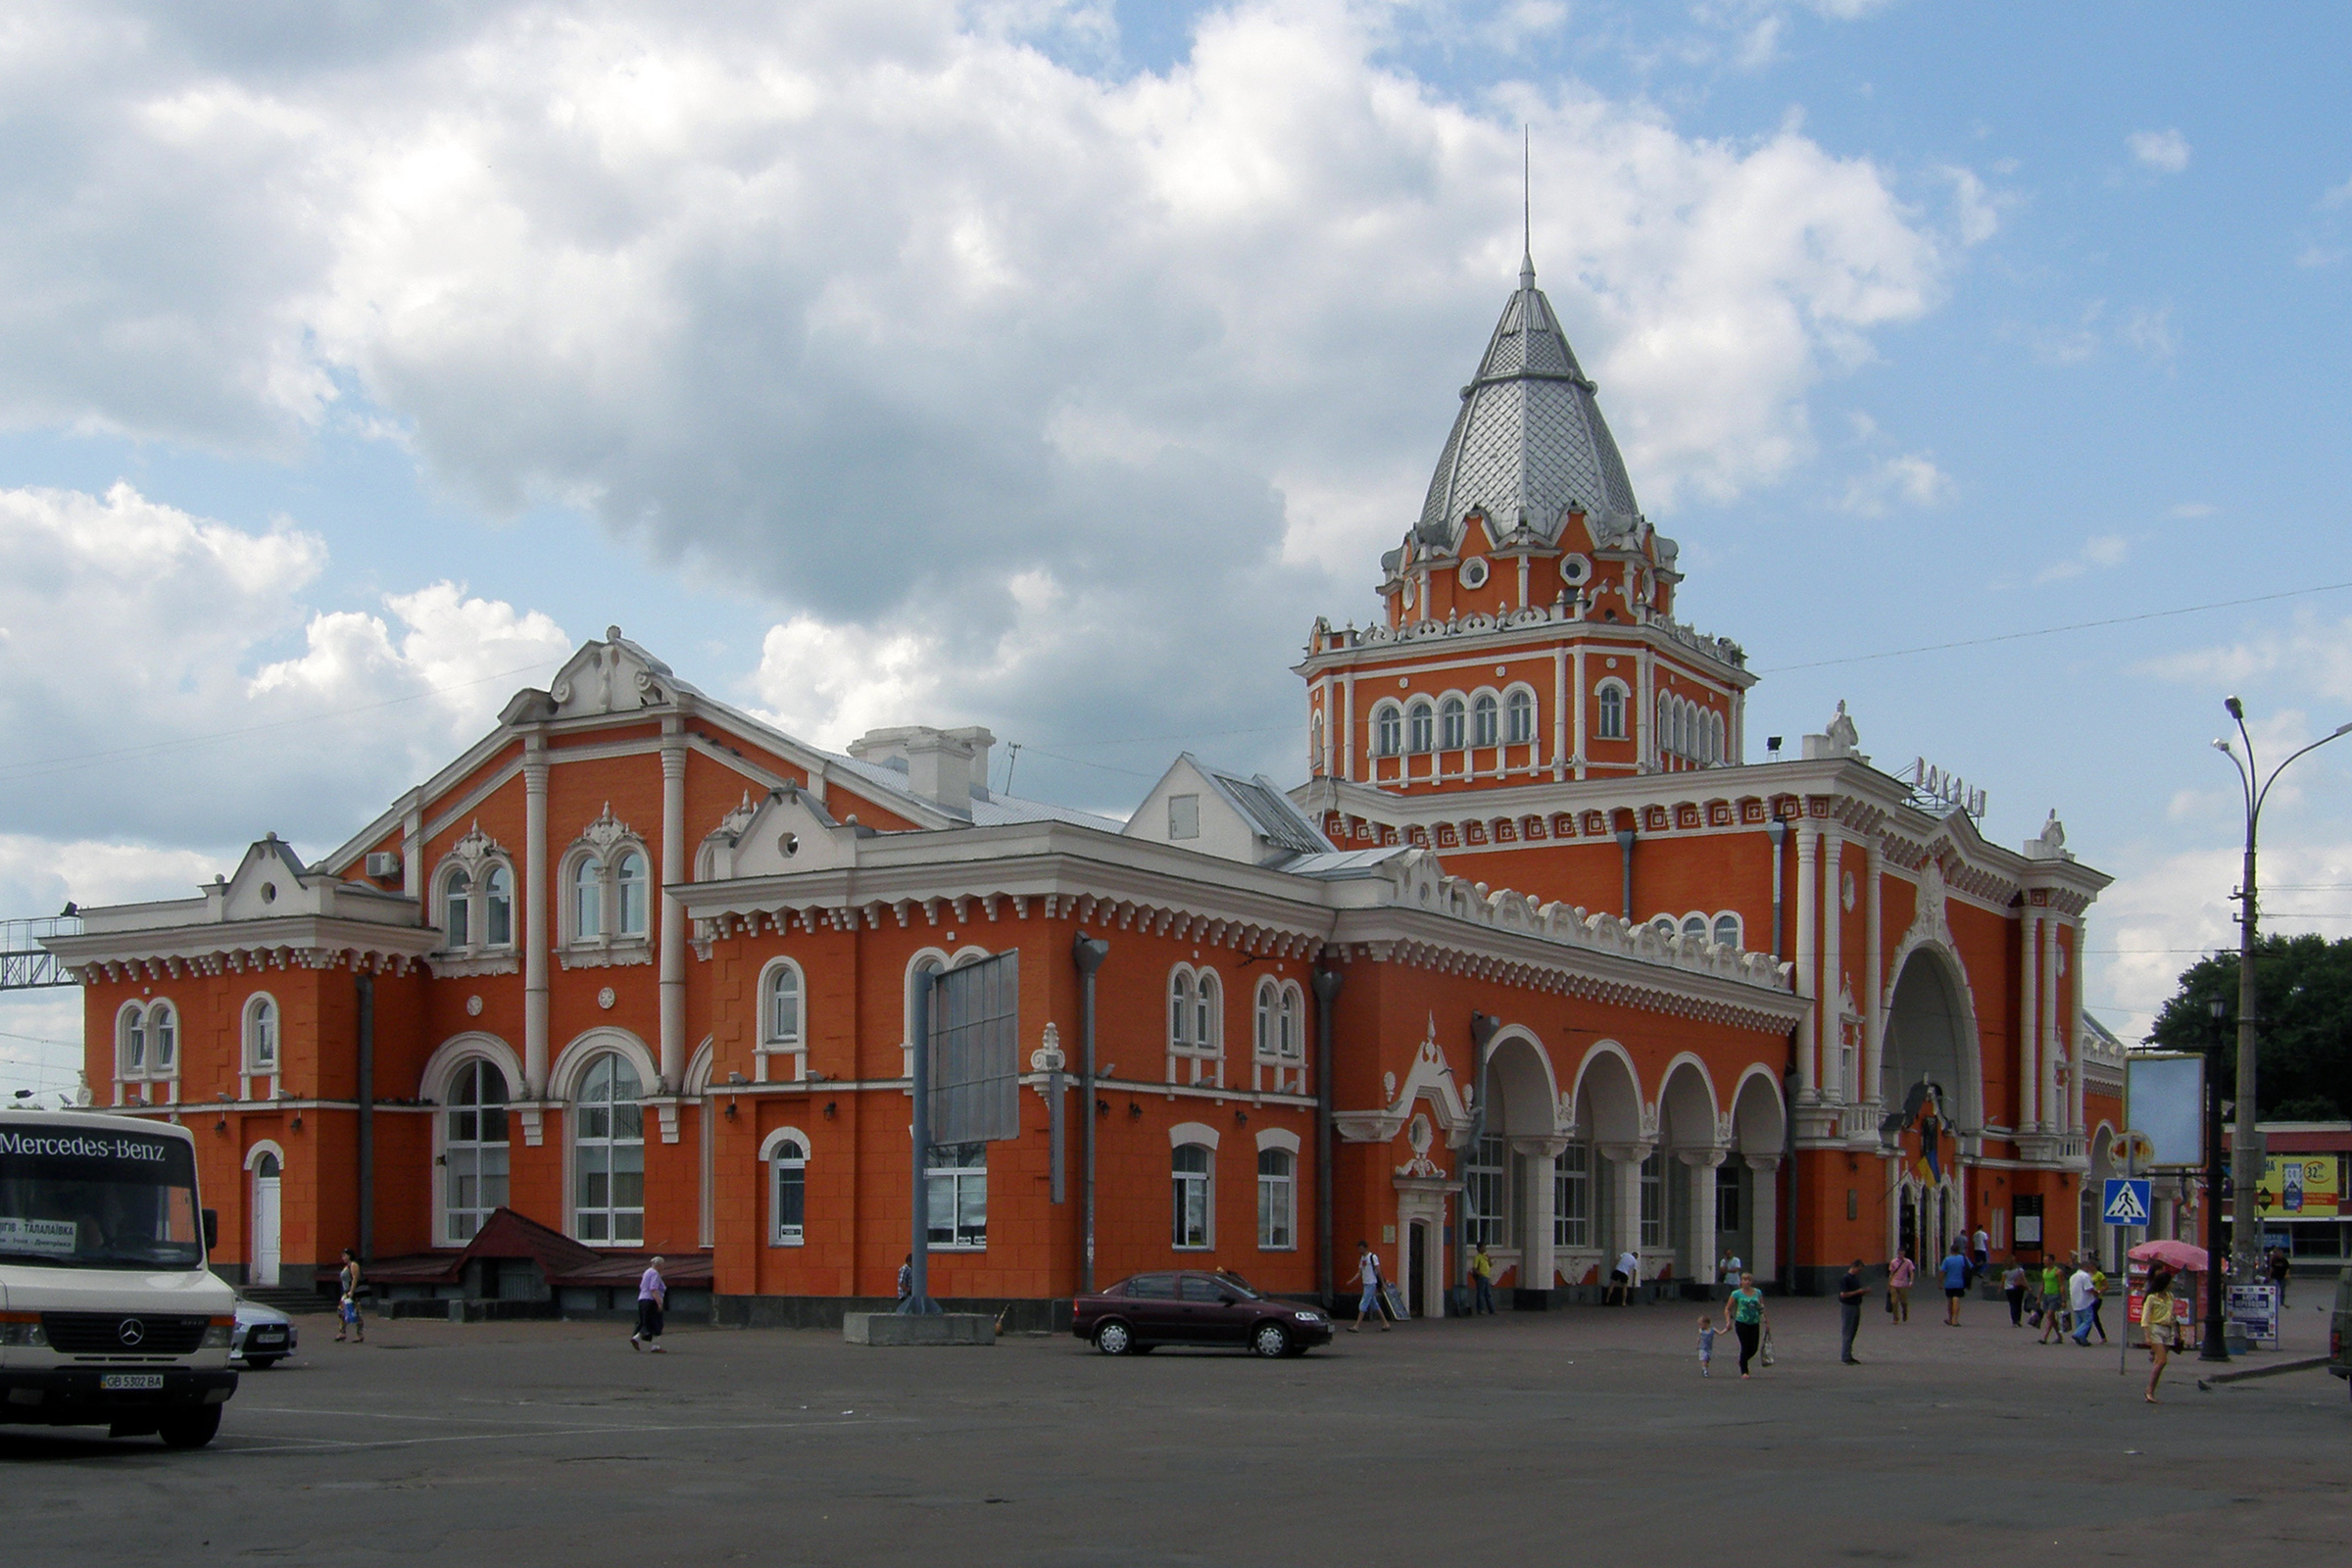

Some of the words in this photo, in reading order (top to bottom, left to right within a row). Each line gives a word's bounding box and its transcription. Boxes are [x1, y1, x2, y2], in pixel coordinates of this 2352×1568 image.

[0, 1133, 166, 1161] Mercedes-Benz
[24, 1223, 74, 1236] ТАЛАЛАЇВКА
[123, 1376, 146, 1387] 5302
[147, 1376, 162, 1387] BA
